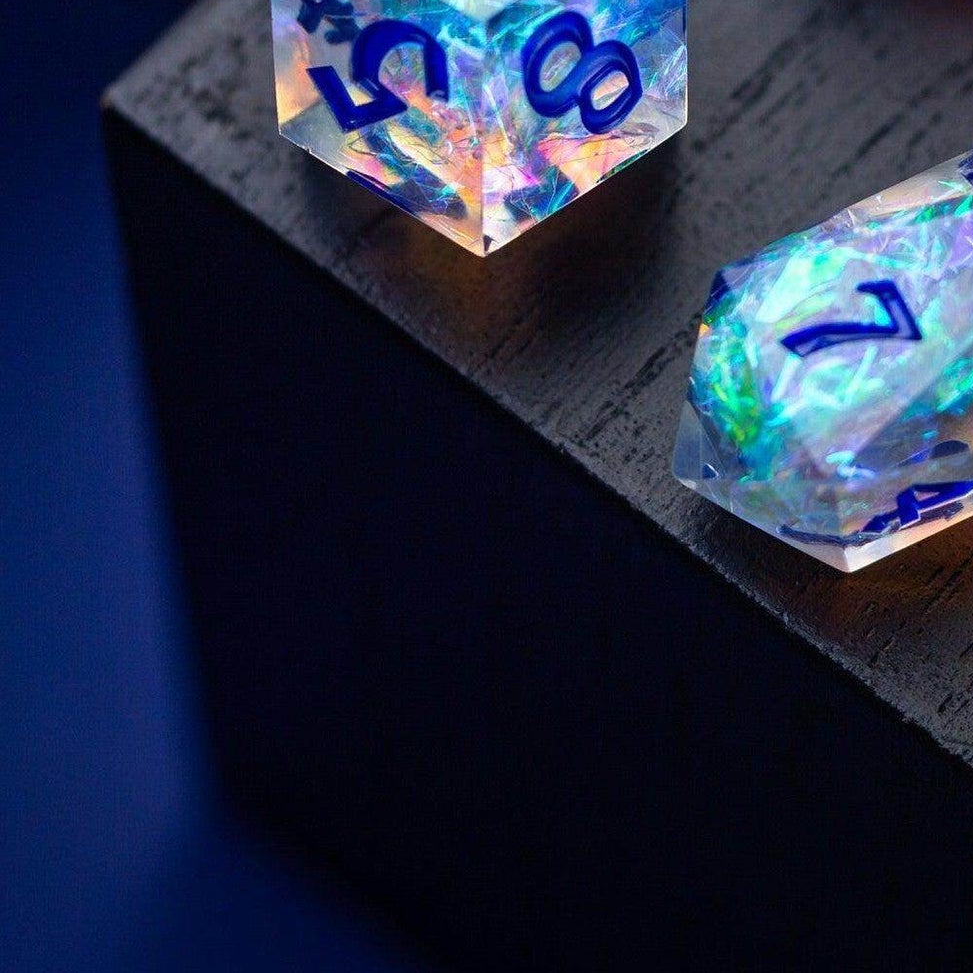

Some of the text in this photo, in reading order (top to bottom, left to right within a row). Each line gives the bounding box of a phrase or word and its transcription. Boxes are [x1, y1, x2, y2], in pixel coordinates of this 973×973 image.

[306, 19, 449, 133] 5
[522, 11, 643, 135] 8
[780, 279, 922, 358] 7
